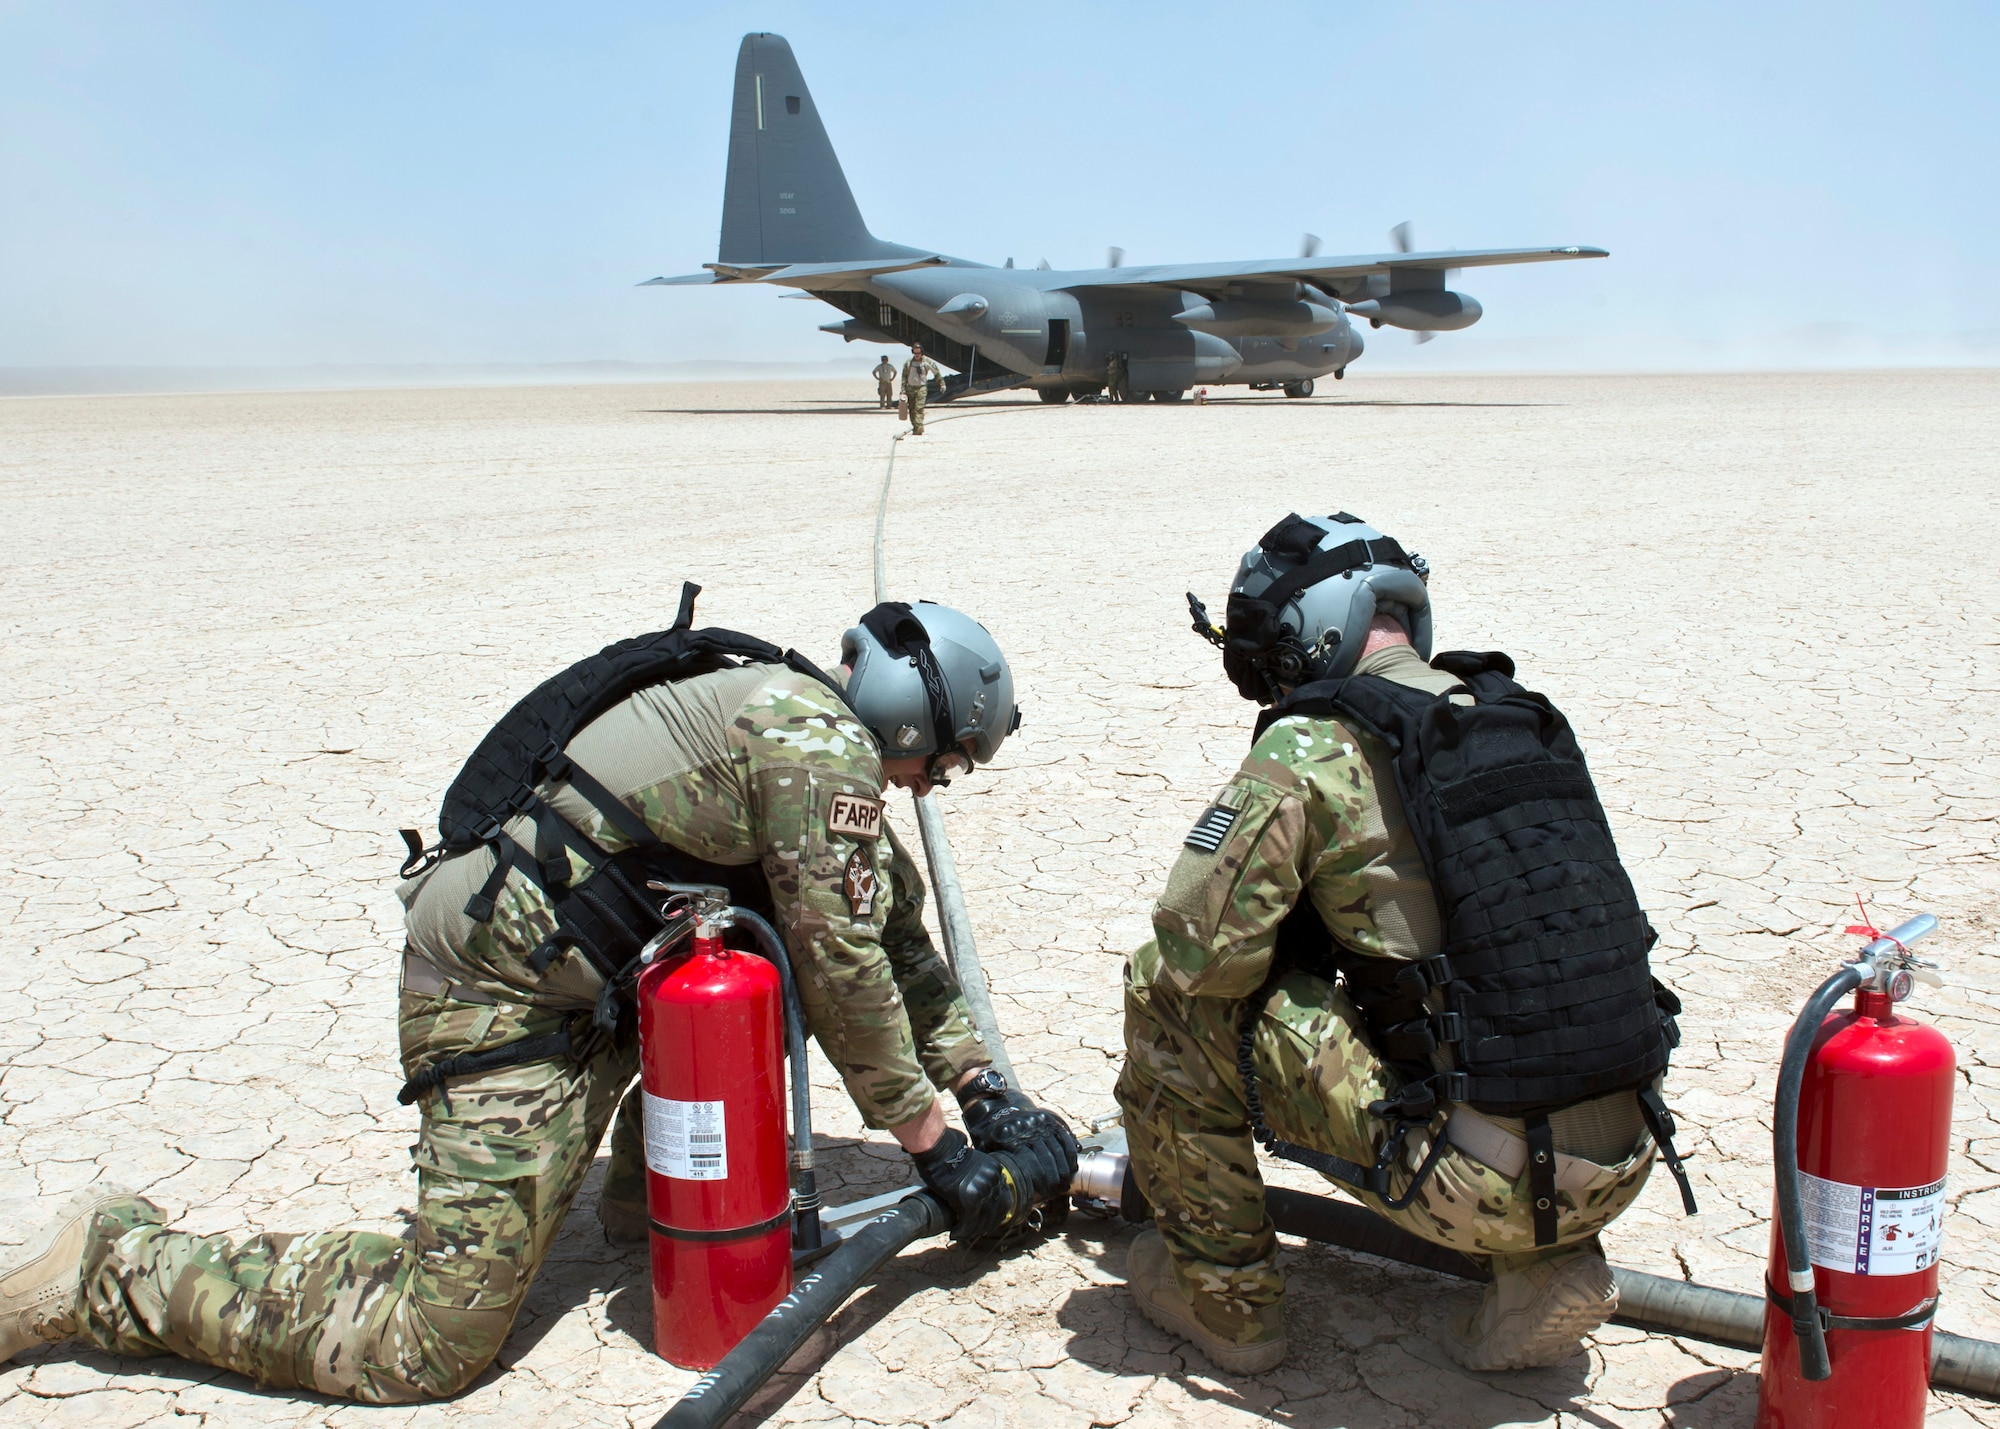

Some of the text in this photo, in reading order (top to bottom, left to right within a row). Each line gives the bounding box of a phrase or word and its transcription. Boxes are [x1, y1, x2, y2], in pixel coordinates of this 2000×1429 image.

[779, 192, 795, 200] USAF
[833, 801, 878, 829] FARP
[1858, 1193, 1872, 1272] PURPLE K
